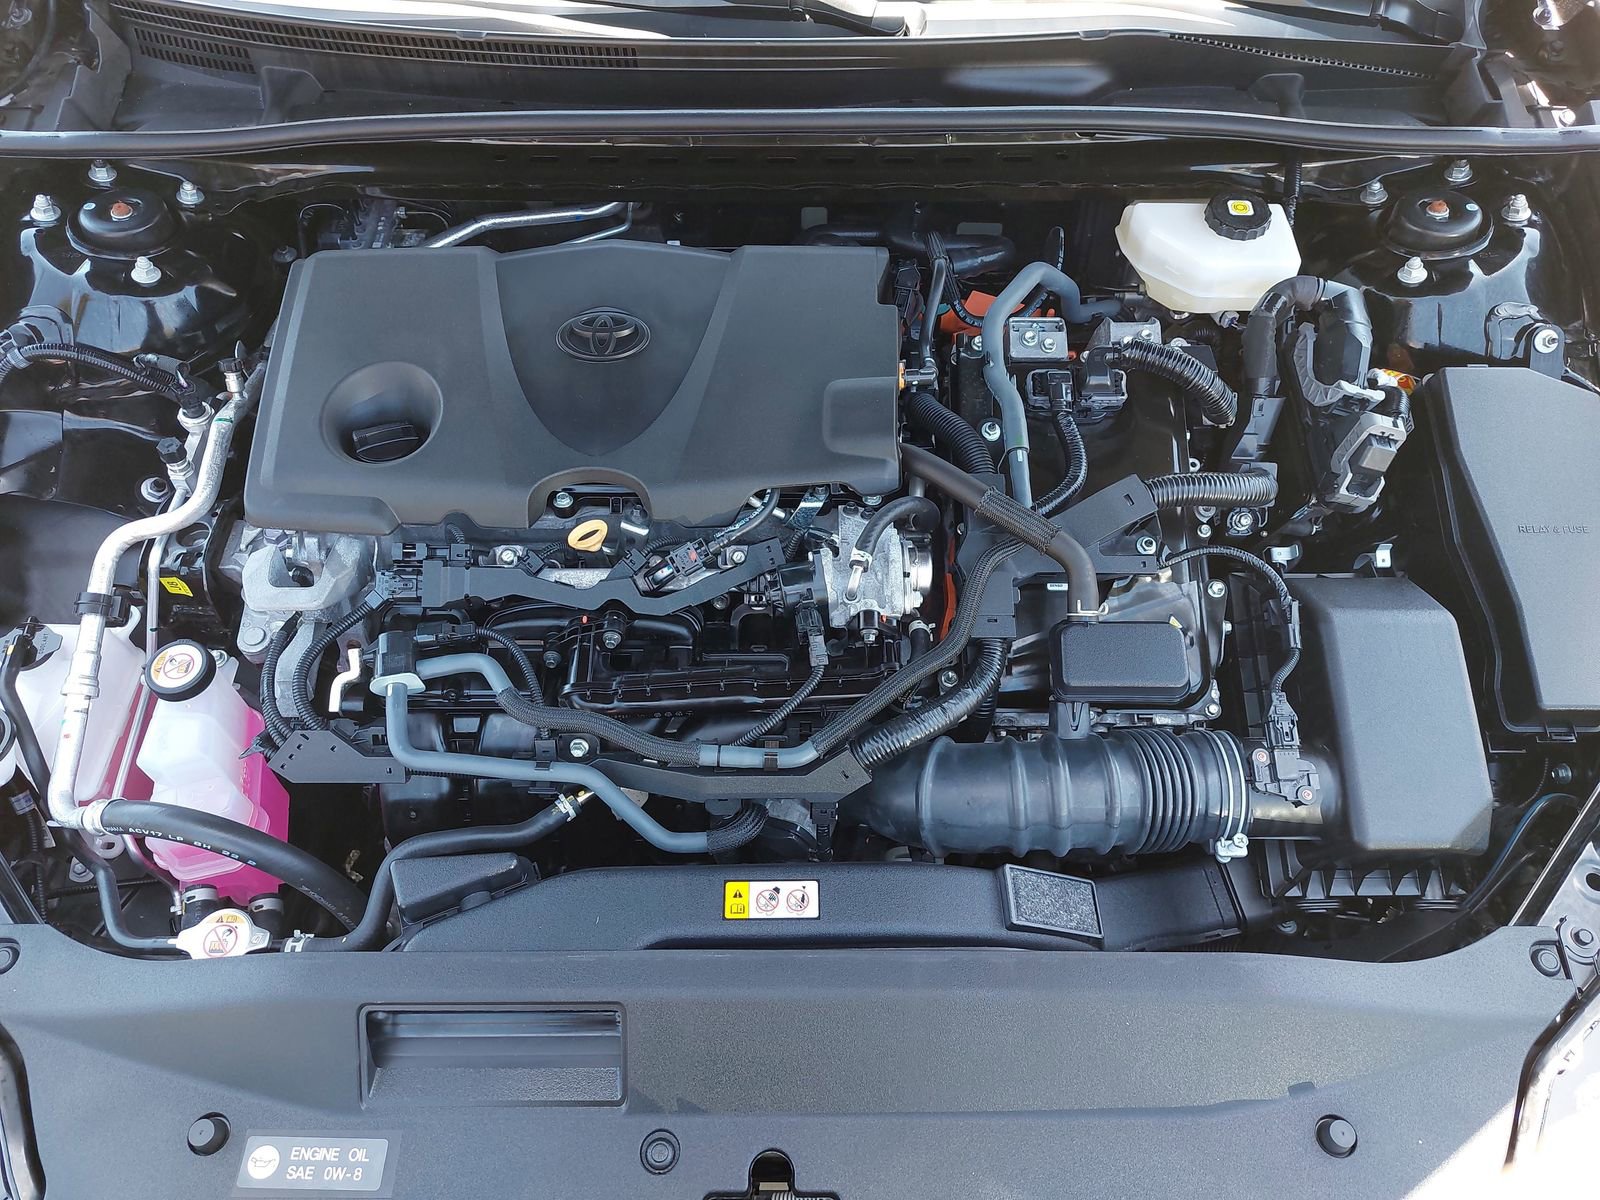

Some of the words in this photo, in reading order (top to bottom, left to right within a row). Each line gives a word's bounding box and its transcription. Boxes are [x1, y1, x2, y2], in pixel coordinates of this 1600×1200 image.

[1518, 524, 1550, 534] RELAY
[1552, 524, 1561, 534] &
[1562, 524, 1590, 534] FUSE
[290, 1146, 341, 1162] ENGINE
[348, 1147, 370, 1162] OIL
[286, 1165, 315, 1180] SAE
[323, 1166, 363, 1181] 0W-8
